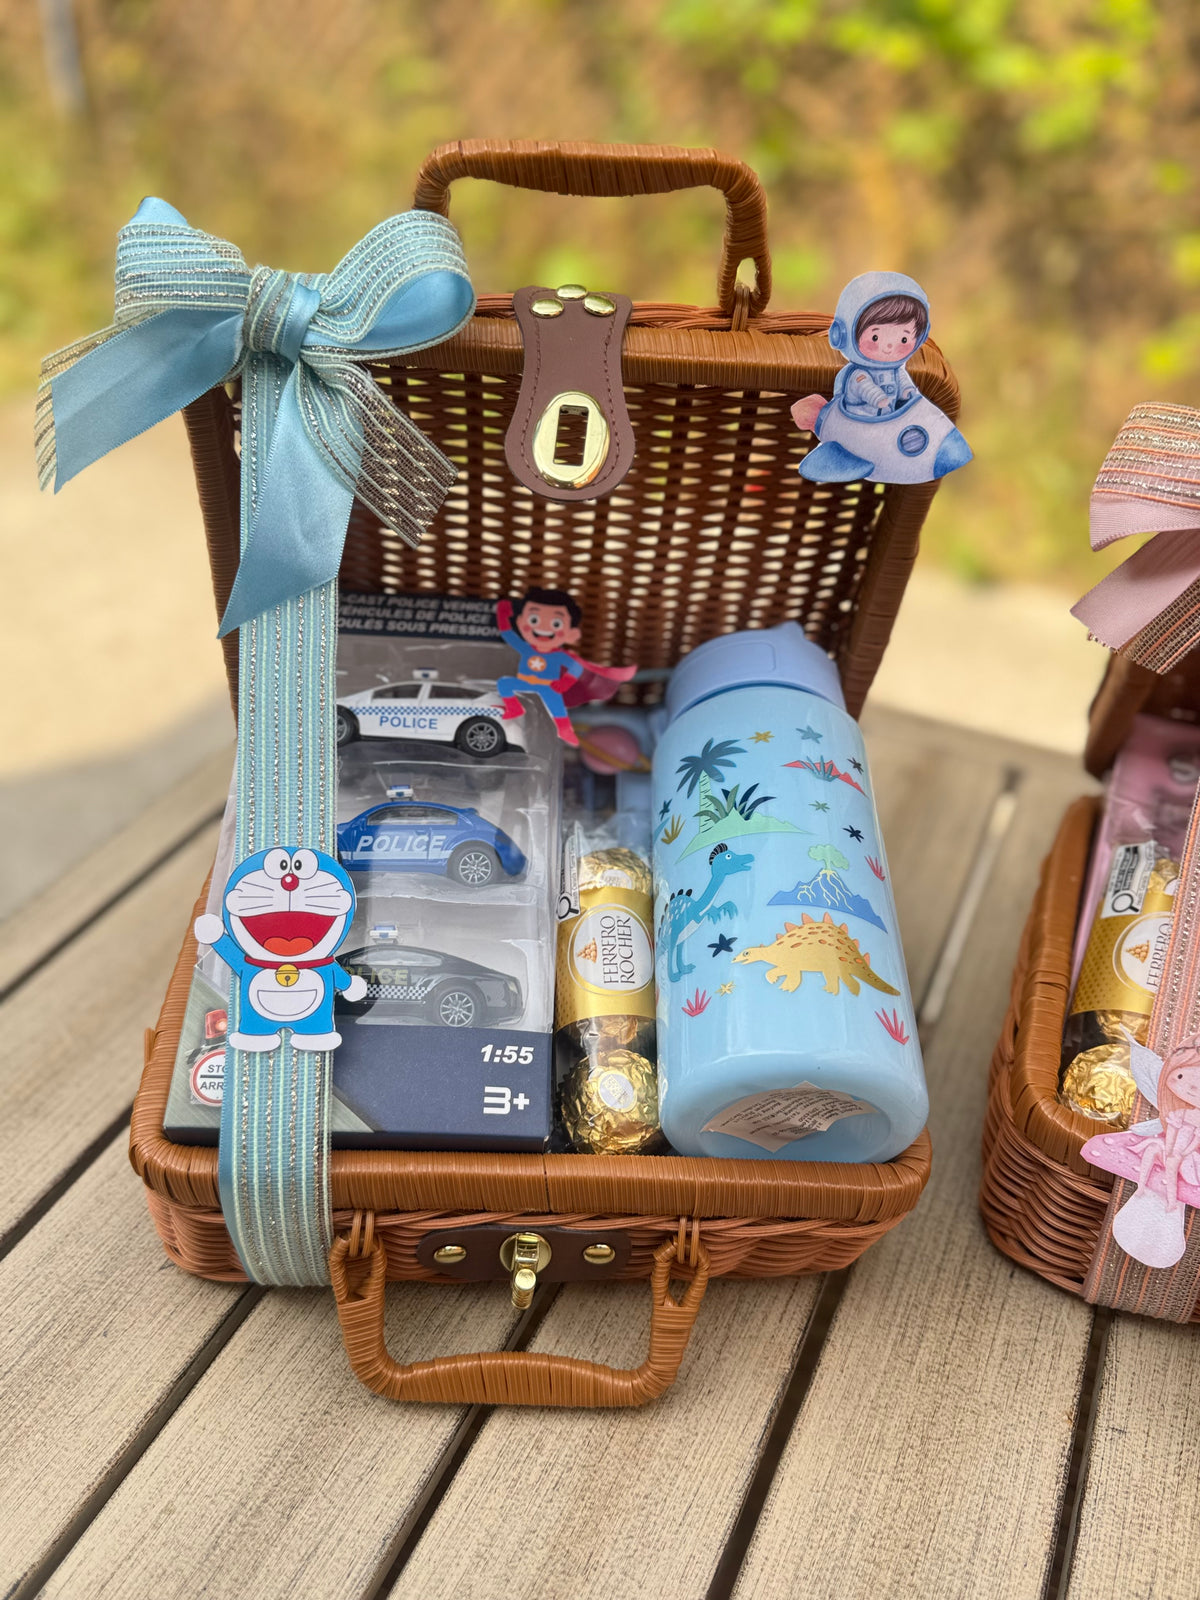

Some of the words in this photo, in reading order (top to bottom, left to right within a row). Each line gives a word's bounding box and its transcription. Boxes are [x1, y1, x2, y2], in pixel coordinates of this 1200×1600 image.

[387, 597, 440, 609] POLICE
[338, 617, 384, 630] OULÉS
[386, 620, 427, 633] SOUS
[415, 609, 436, 621] DE
[438, 611, 491, 624] POLICE
[379, 715, 438, 730] POLICE
[356, 834, 448, 852] POLICE
[600, 915, 619, 984] FERRERO
[616, 916, 636, 984] ROCHER
[481, 1044, 534, 1064] 1:55
[483, 1086, 530, 1115] 3+
